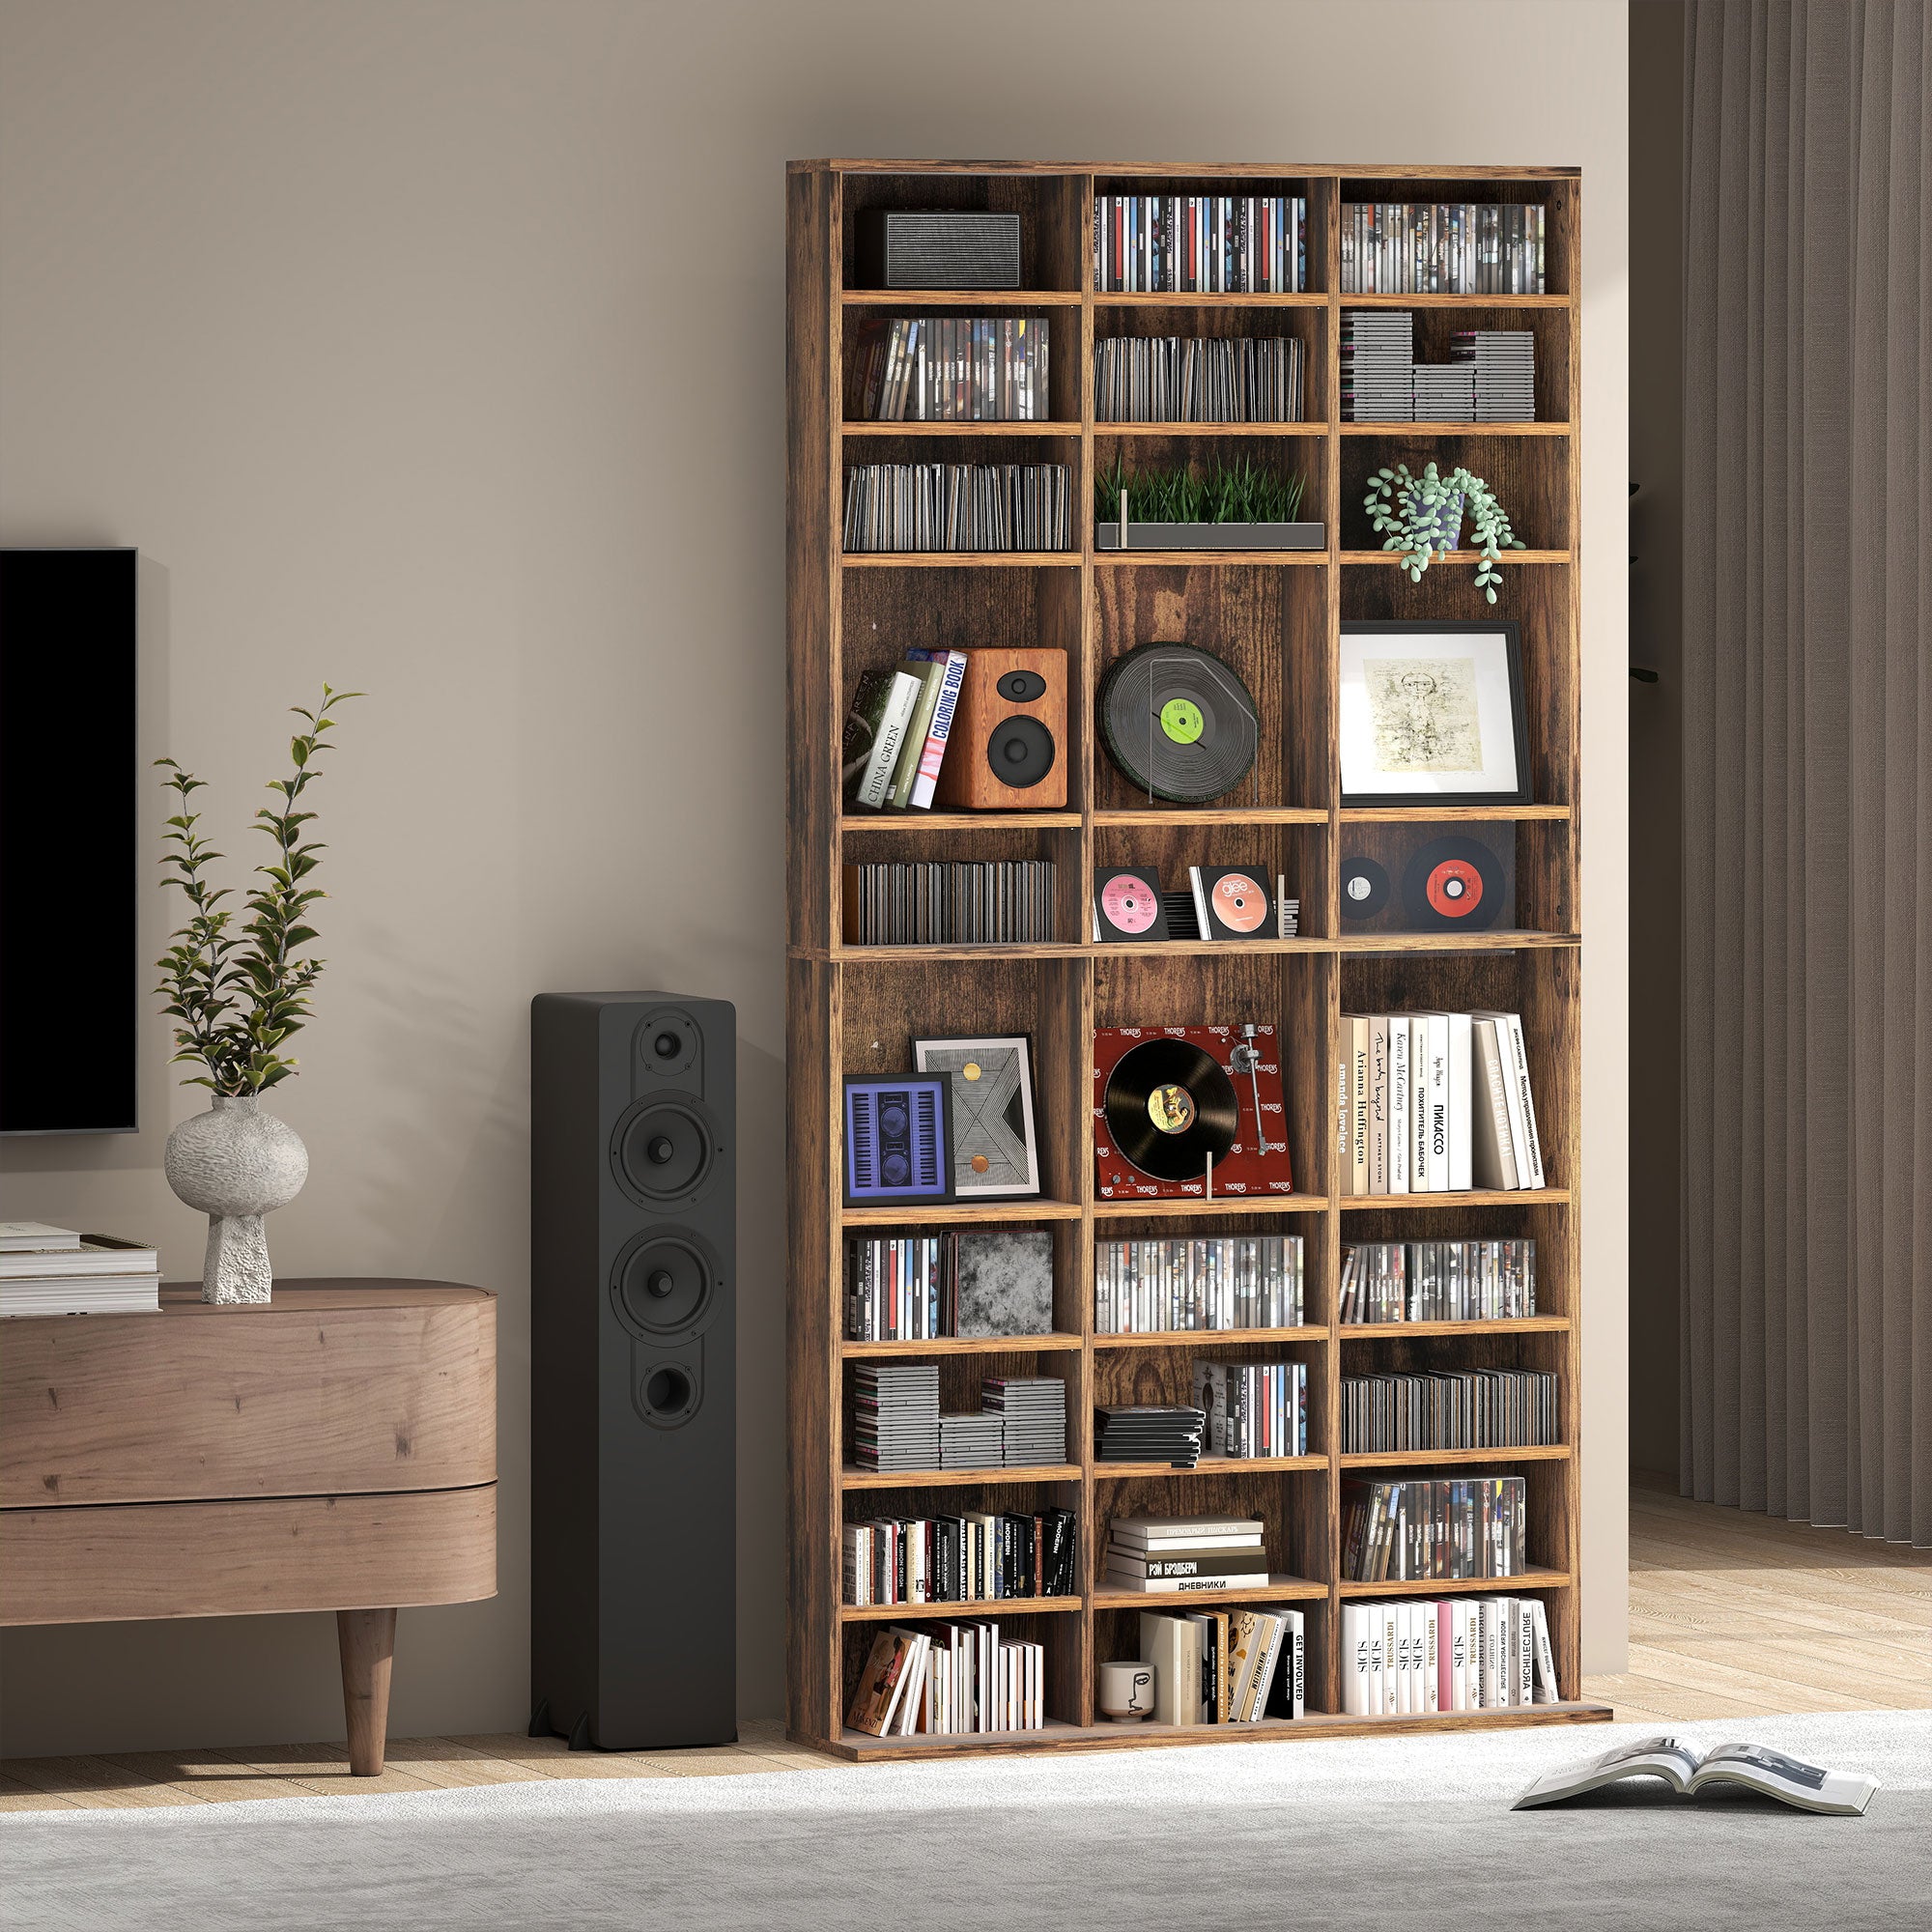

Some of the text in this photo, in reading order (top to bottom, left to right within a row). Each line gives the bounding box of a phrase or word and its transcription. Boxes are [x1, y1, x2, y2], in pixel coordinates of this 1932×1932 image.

[931, 660, 966, 739] COLORING BOOK
[867, 724, 901, 803] CHINA GREEN
[1222, 881, 1248, 896] glee
[1120, 1028, 1142, 1037] THORENS
[1164, 1027, 1186, 1037] THORENS
[1208, 1026, 1230, 1036] THORENS
[1258, 1026, 1273, 1036] ORENS
[1397, 1033, 1406, 1060] Karen
[1371, 1032, 1386, 1122] The body beyond
[1394, 1063, 1406, 1112] McCartney
[1520, 1075, 1528, 1097] Метод
[1261, 1103, 1283, 1113] THORENS
[1355, 1051, 1367, 1165] Arianna Huffington
[1434, 1105, 1444, 1155] ПИКАССО
[1097, 1148, 1110, 1157] RENS
[1101, 1186, 1114, 1196] RENS
[1136, 1185, 1158, 1196] THORENS
[1180, 1184, 1202, 1194] THORENS
[1225, 1182, 1246, 1192] THORENS
[1269, 1180, 1291, 1191] THORENS
[1053, 1520, 1063, 1553] MODERN
[1149, 1561, 1198, 1577] РЭЙ БРЭДБЕРИ
[1179, 1580, 1227, 1590] ДНЕВНИКИ
[1357, 1640, 1368, 1673] SICIS
[1372, 1640, 1381, 1672] SICIS
[1399, 1638, 1409, 1671] SICIS
[1413, 1637, 1423, 1669] SICIS
[1455, 1636, 1464, 1667] SICIS
[1252, 1651, 1266, 1691] MINIMALISM
